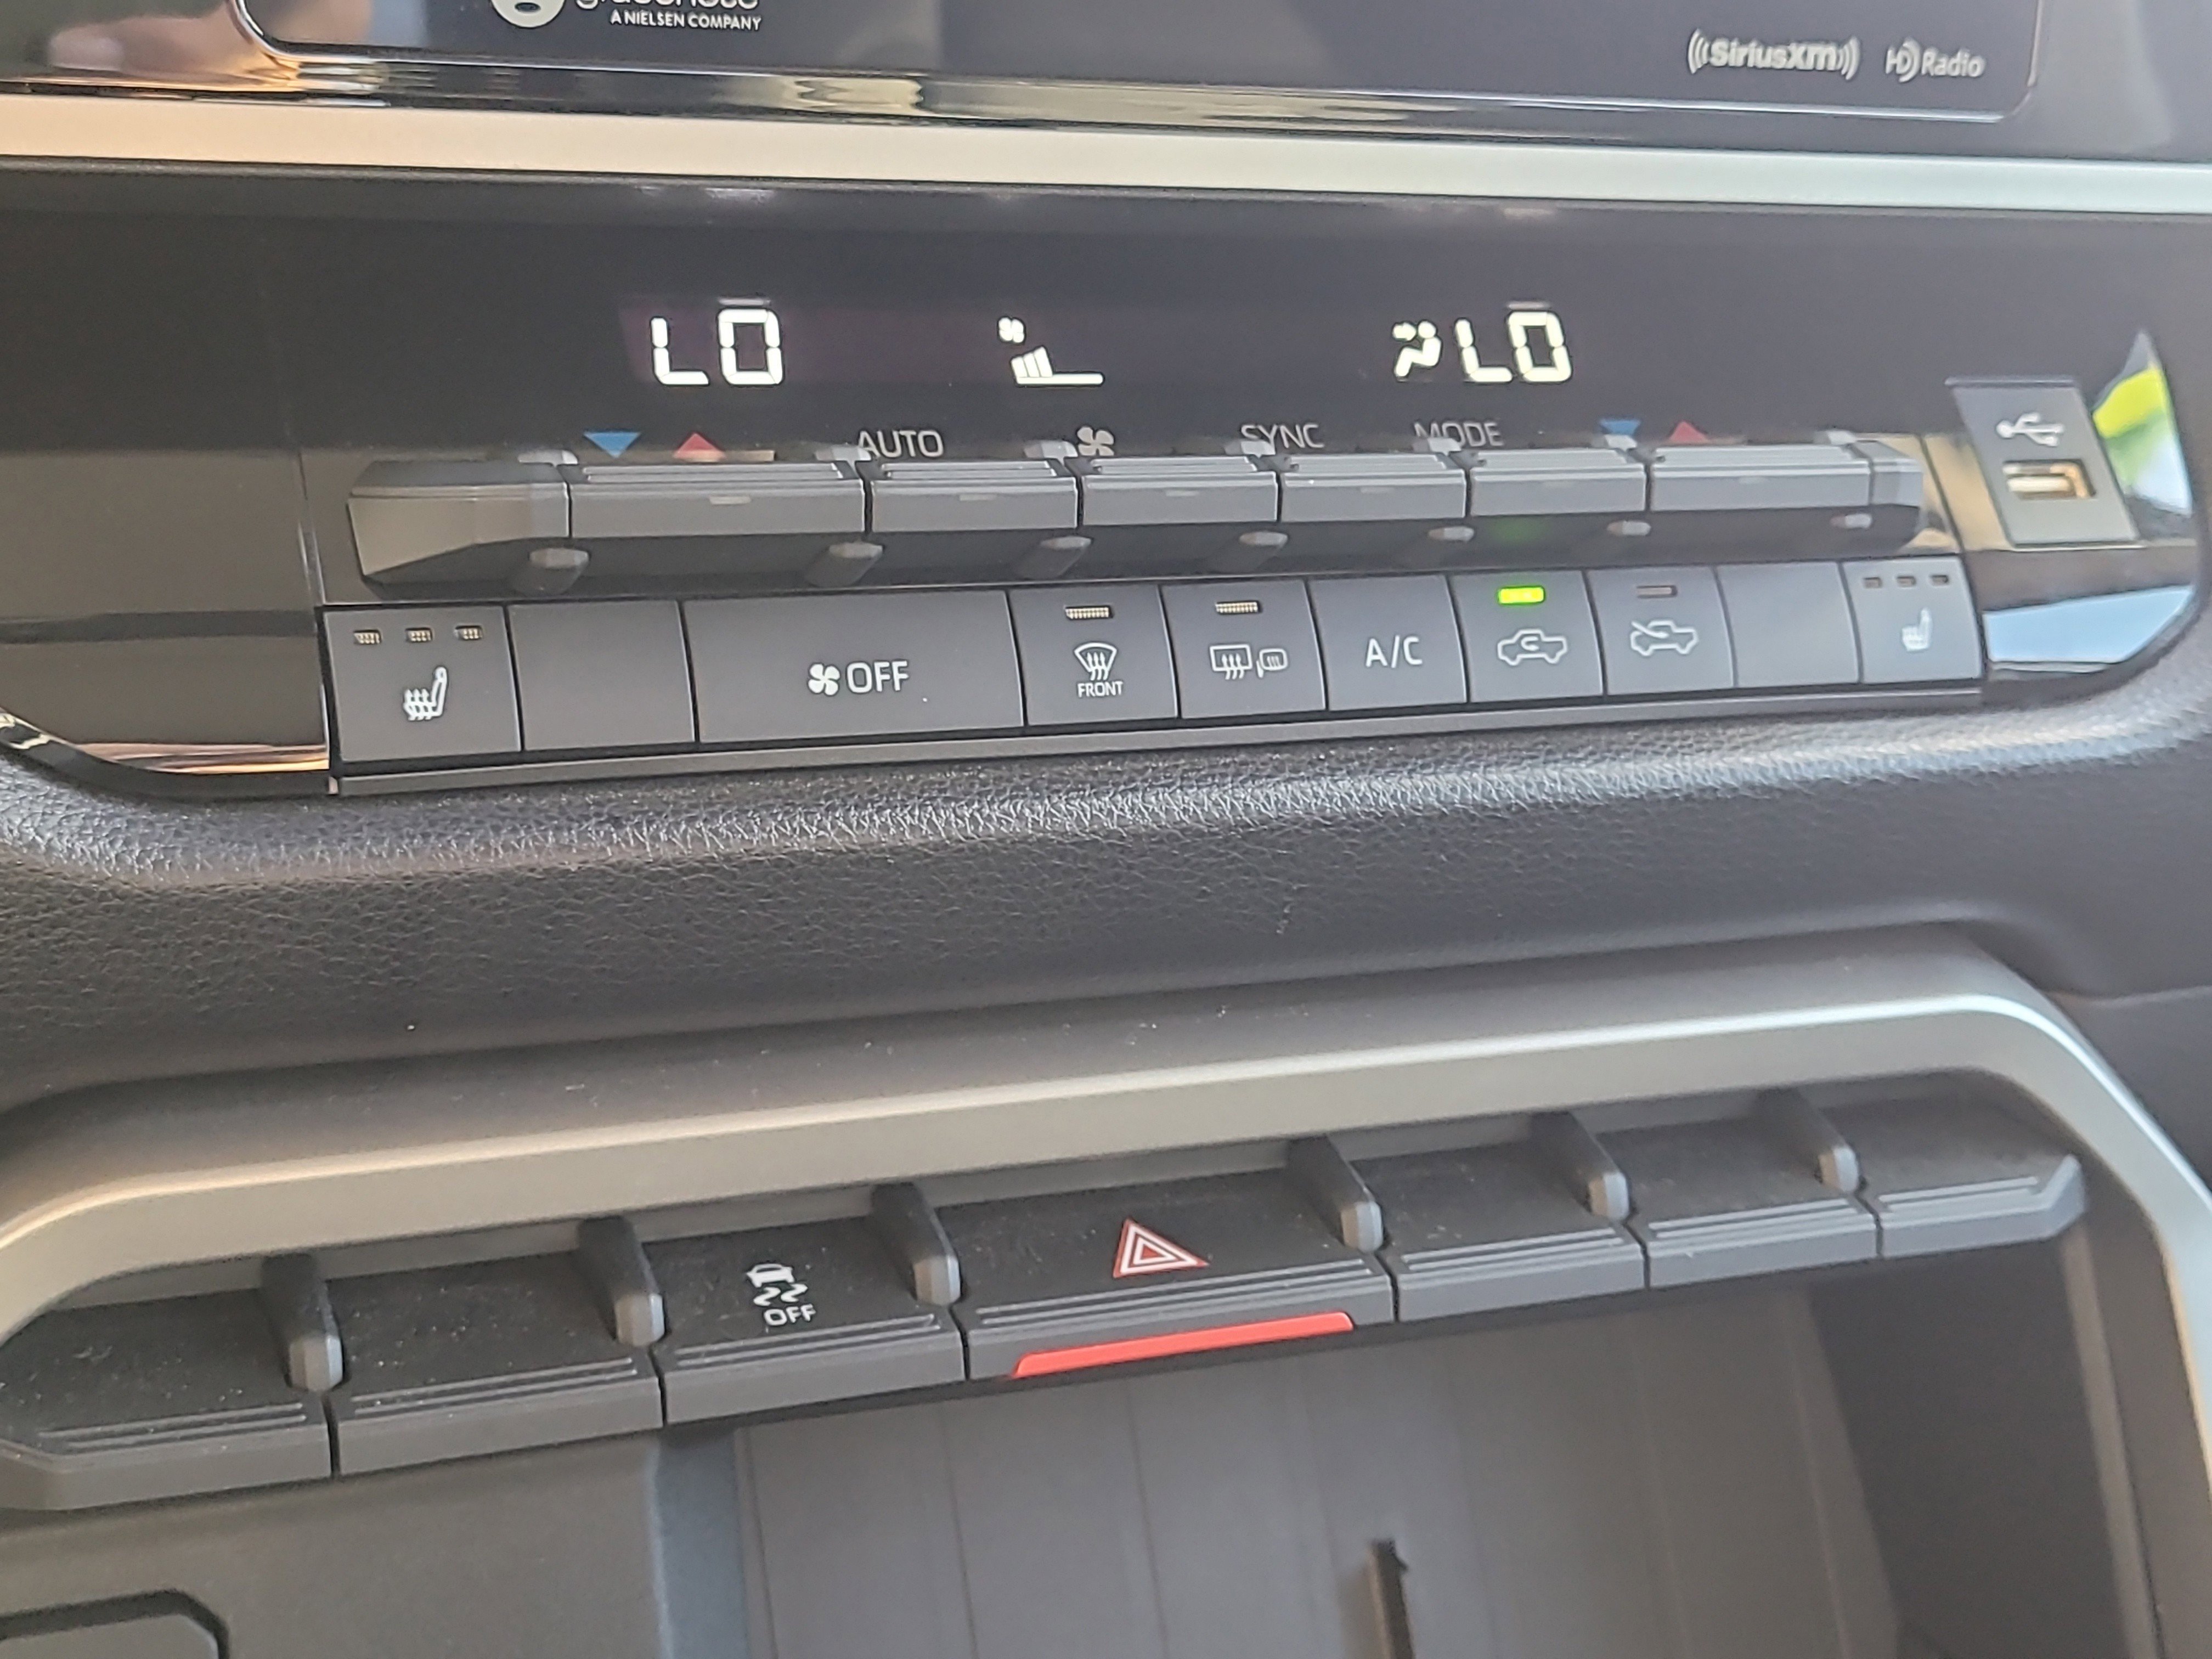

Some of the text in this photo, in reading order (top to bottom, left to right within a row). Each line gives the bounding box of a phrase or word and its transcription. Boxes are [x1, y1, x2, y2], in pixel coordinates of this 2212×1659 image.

[611, 9, 761, 31] A NIELSEN COMPANY
[1921, 47, 1985, 77] Radio
[858, 430, 944, 458] AUTO
[1240, 422, 1325, 449] SYNC
[1414, 421, 1504, 447] MODE
[1365, 635, 1423, 668] A/C
[847, 660, 909, 693] OFF
[1077, 680, 1124, 698] FRONT
[764, 1304, 816, 1327] OFF
